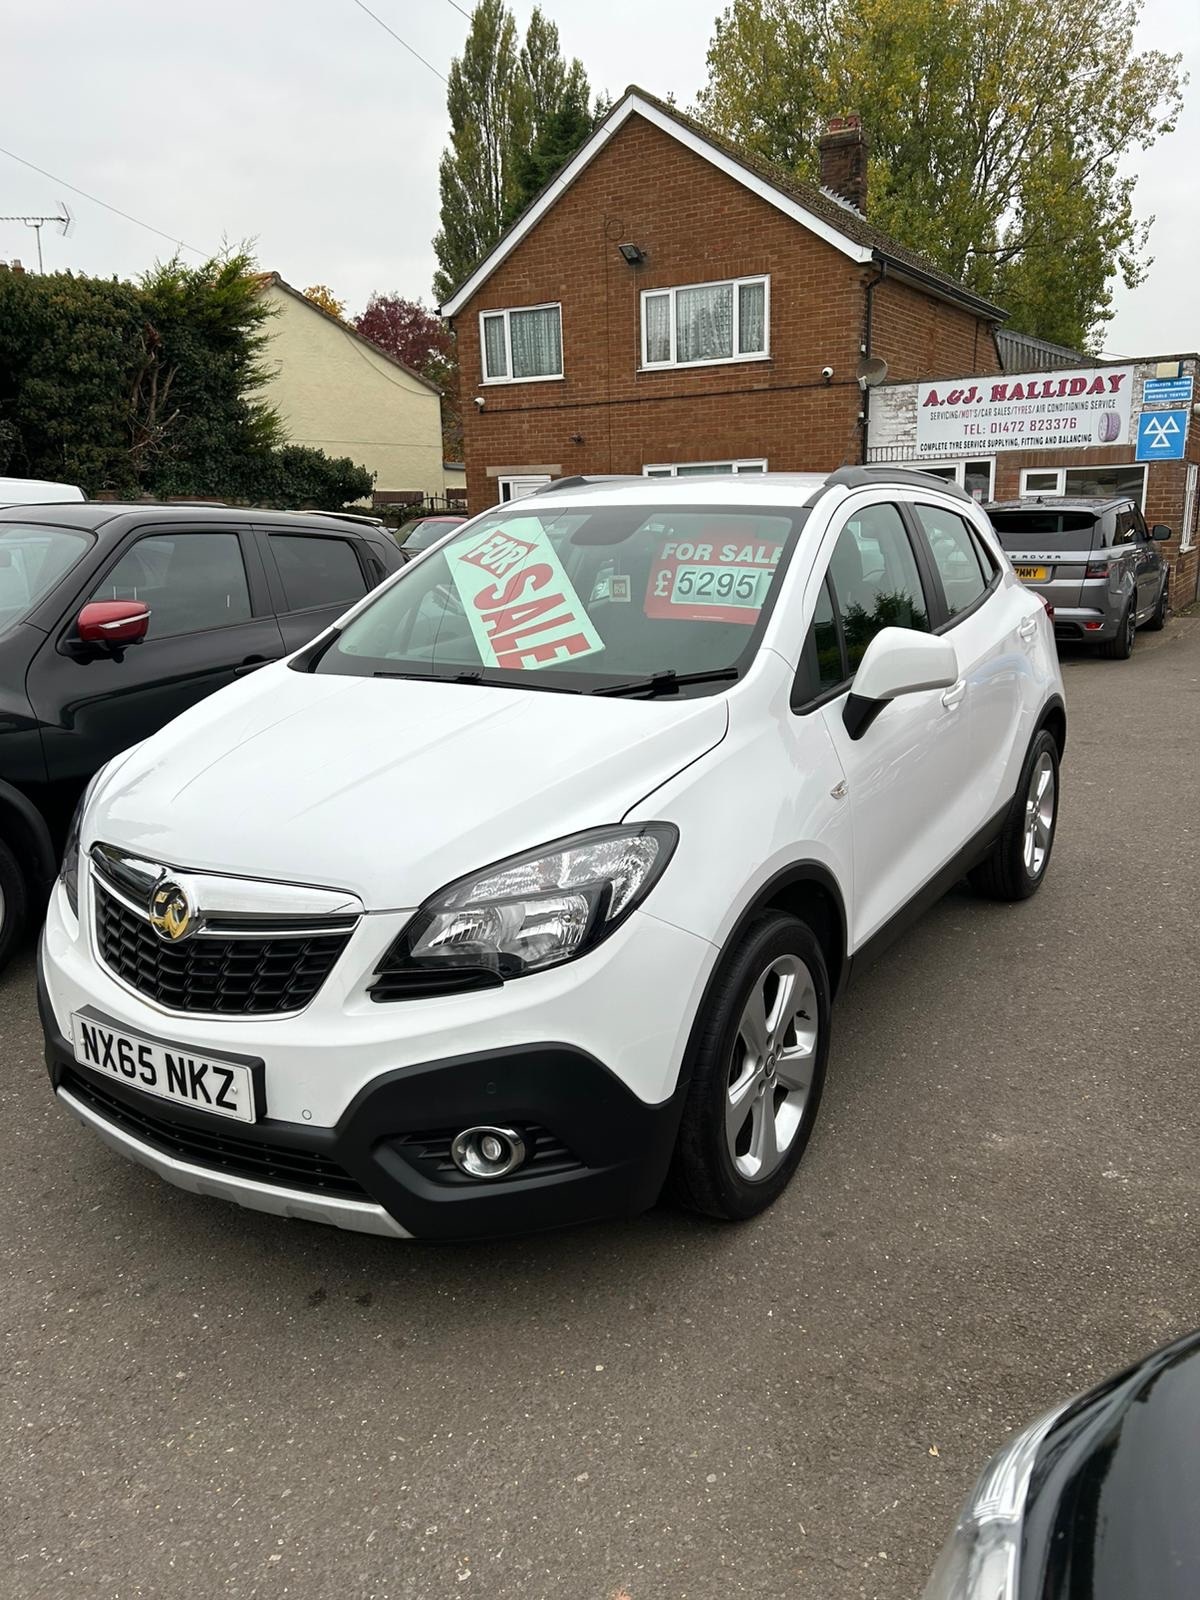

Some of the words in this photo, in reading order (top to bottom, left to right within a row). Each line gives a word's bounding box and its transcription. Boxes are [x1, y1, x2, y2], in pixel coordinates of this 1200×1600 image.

[989, 374, 1126, 402] HALLIDAY
[1047, 401, 1088, 412] CONDITIONING
[1090, 399, 1116, 410] SERVICE
[964, 424, 986, 435] TEL:
[990, 421, 1025, 433] 01472
[1029, 418, 1077, 431] 823376
[920, 442, 947, 451] COMPLETE
[949, 441, 962, 450] TYRE
[963, 439, 986, 449] SERVICE
[987, 438, 1020, 448] SUPPLYING,
[1021, 437, 1043, 446] FITTING
[1045, 436, 1057, 444] AND
[1058, 434, 1092, 444] BALANCING
[467, 535, 529, 574] FOR
[660, 543, 713, 560] FOR
[473, 563, 592, 669] SALE
[81, 1022, 157, 1086] NX65
[165, 1053, 237, 1111] NKZ
